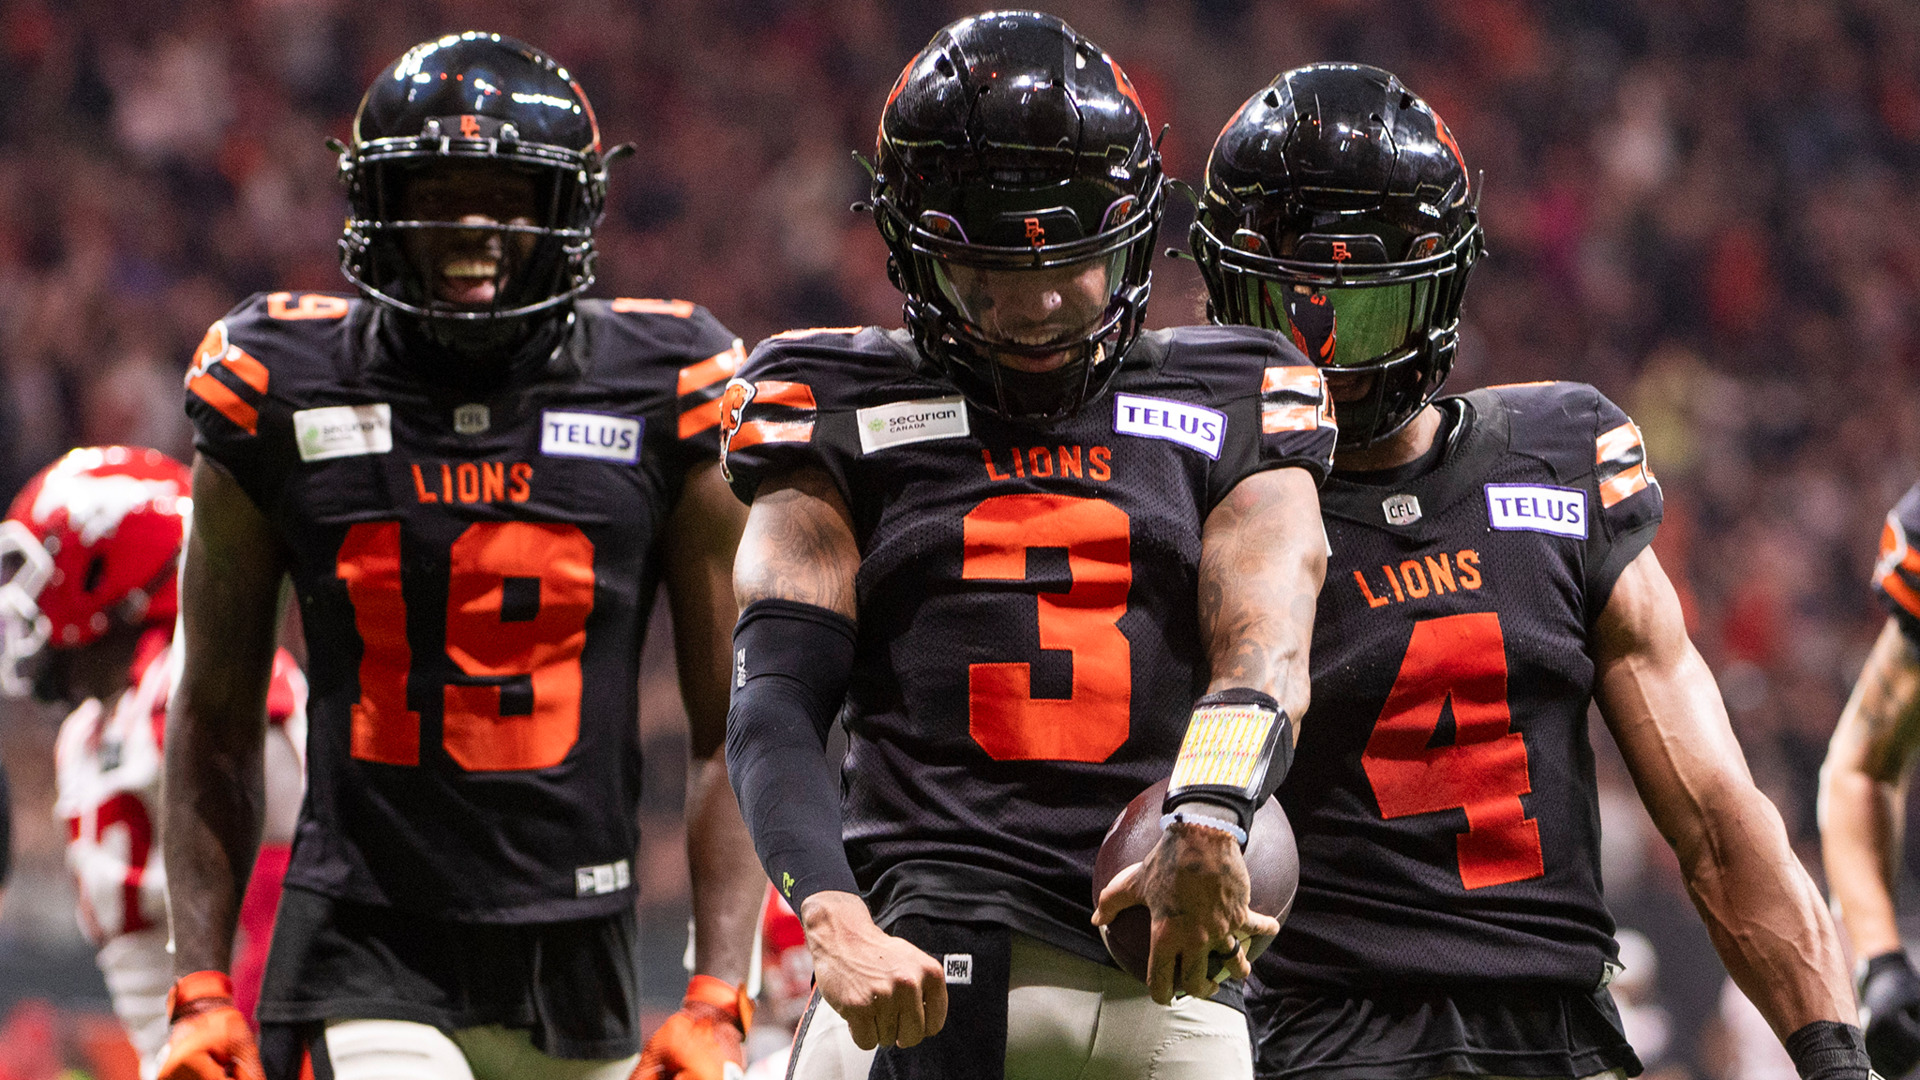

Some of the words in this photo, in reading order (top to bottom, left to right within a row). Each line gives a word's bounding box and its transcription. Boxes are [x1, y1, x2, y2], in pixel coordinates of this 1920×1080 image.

[548, 421, 634, 451] TELUS
[888, 409, 957, 428] securian
[889, 422, 926, 433] CANADA
[1122, 404, 1217, 443] TELUS
[981, 445, 1112, 482] LIONS
[412, 462, 534, 504] LIONS
[1389, 502, 1416, 519] CFL
[1494, 497, 1581, 524] TELUS
[1353, 548, 1483, 609] LIONS
[336, 521, 595, 772] 19
[962, 493, 1132, 764] 3
[1361, 612, 1545, 890] 4
